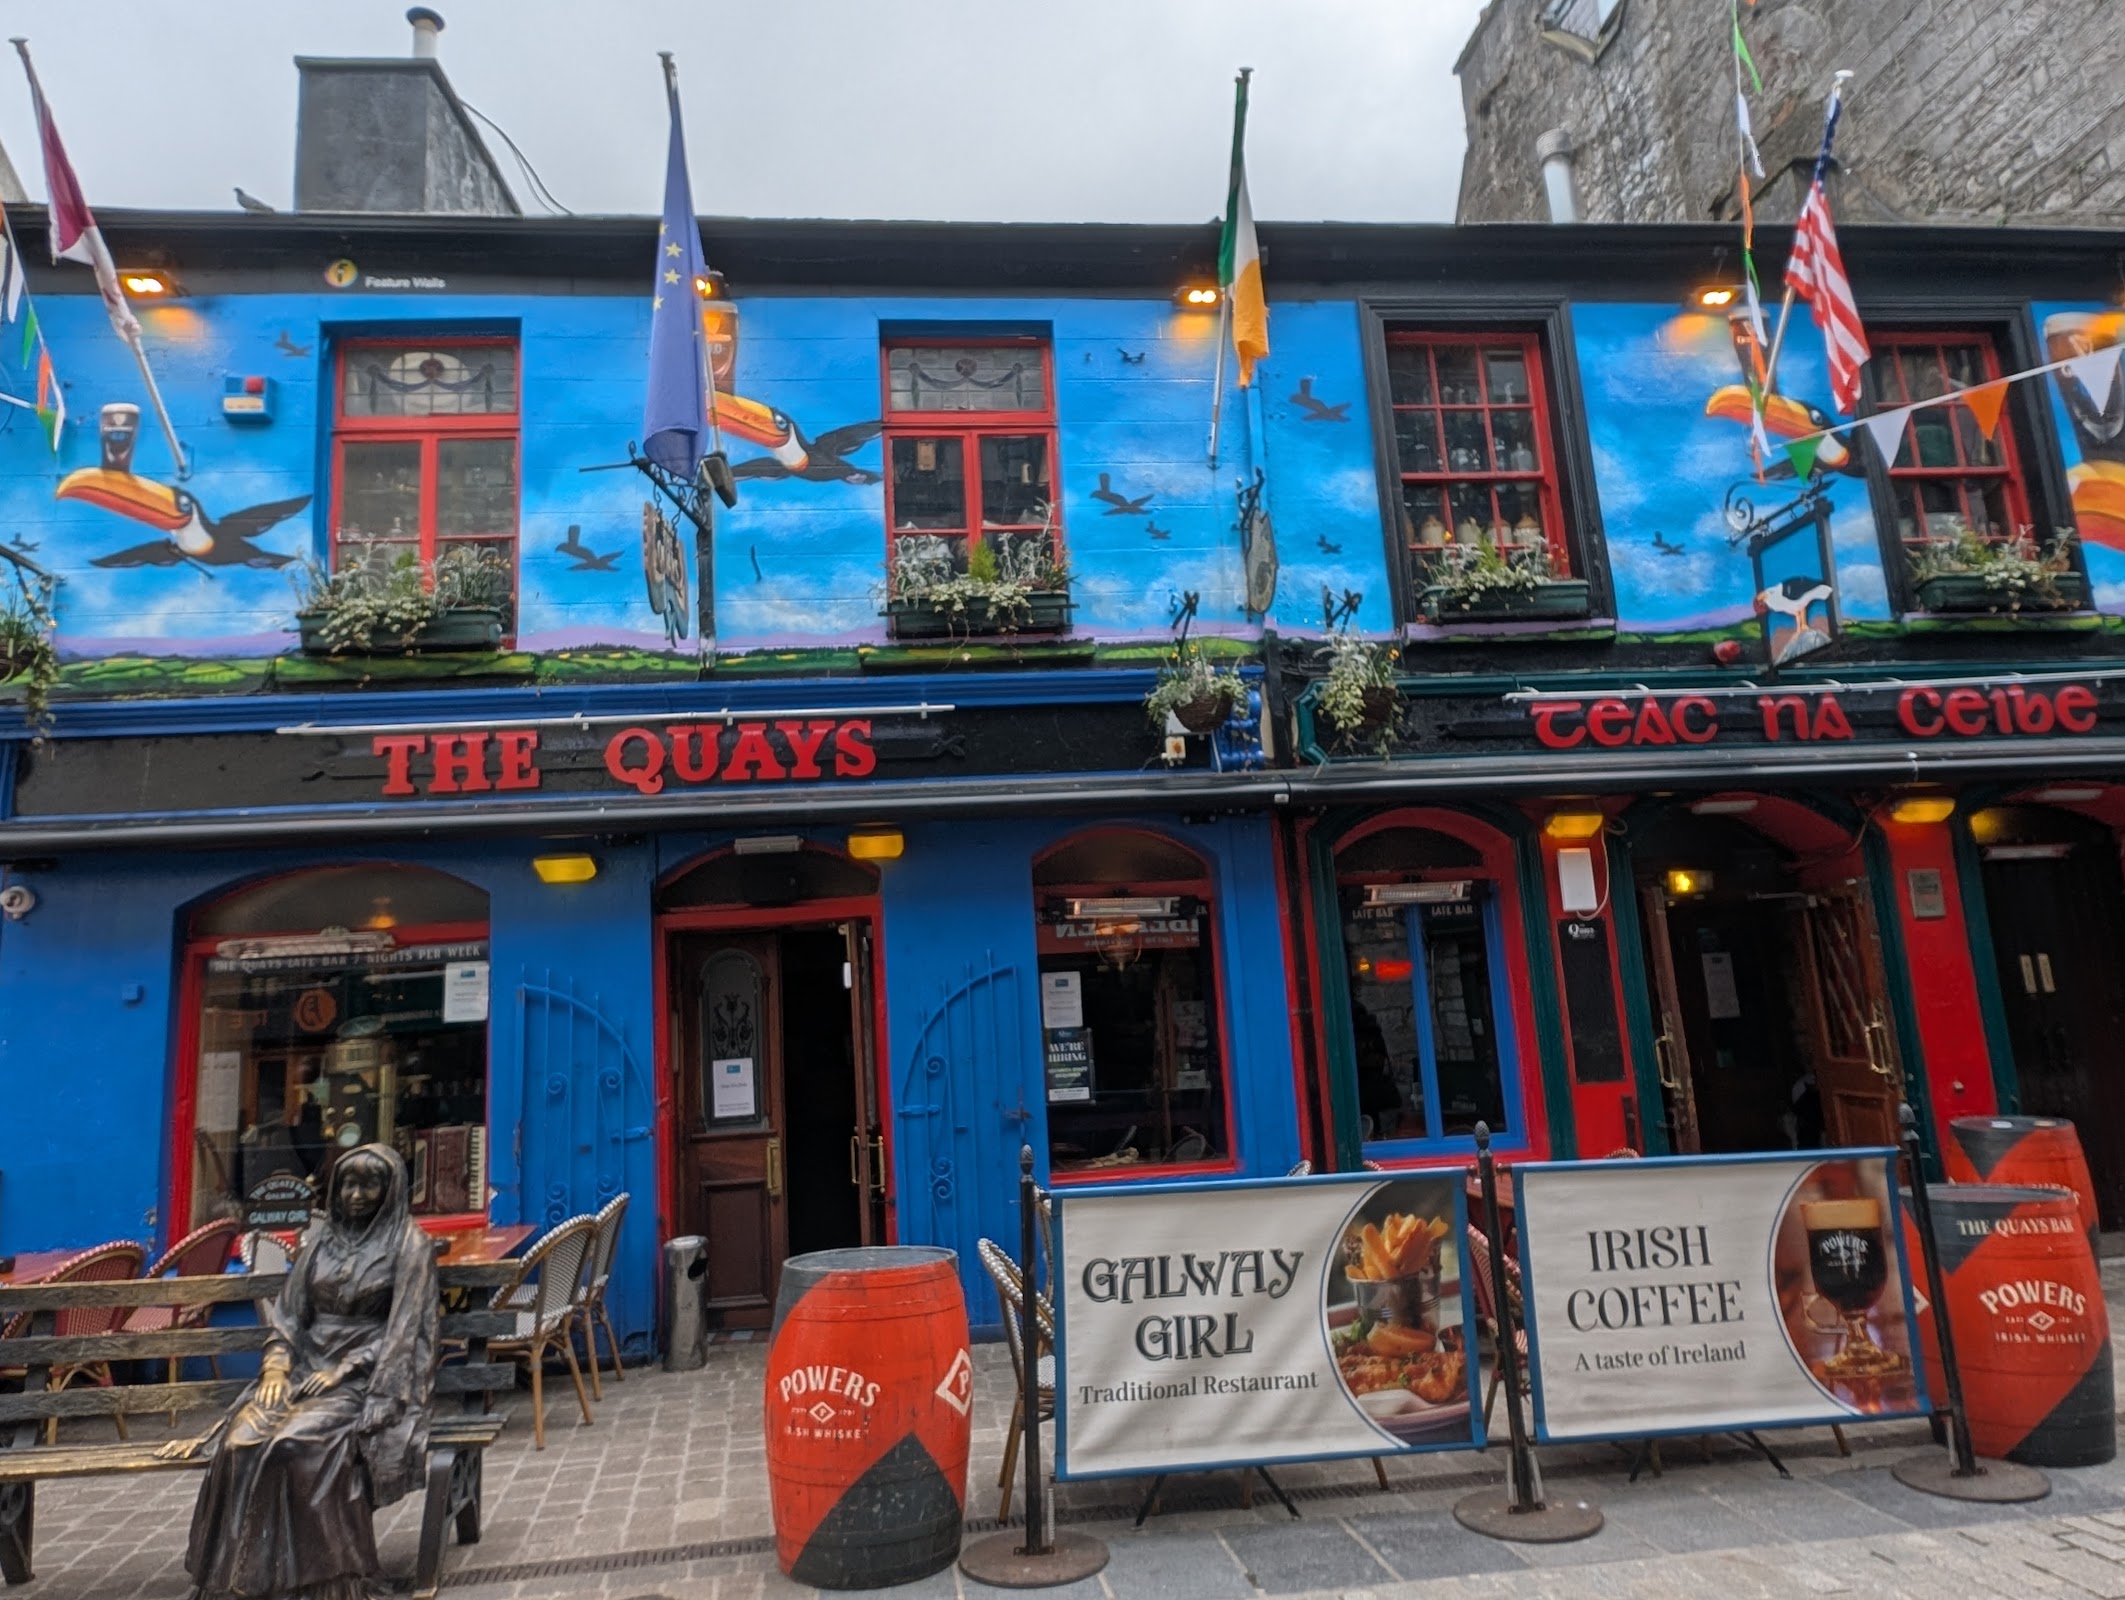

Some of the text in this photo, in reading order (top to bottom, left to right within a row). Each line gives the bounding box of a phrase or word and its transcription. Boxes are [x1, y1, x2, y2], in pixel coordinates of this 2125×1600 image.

[365, 276, 446, 288] Feature Walls
[372, 719, 876, 795] THE QUAYS
[367, 949, 414, 963] NIGHTS
[418, 947, 441, 960] PER
[447, 945, 481, 957] WEEK
[1957, 1218, 2074, 1237] THE QUAYS BAR
[1587, 1225, 1712, 1272] IRISH
[1082, 1248, 1304, 1304] GALWAY
[1567, 1280, 1744, 1332] COFFEE
[1979, 1280, 2087, 1316] POWERS
[1135, 1312, 1254, 1361] GIRL
[1575, 1340, 1746, 1371] A taste of Ireland
[780, 1366, 881, 1407] POWERS
[1080, 1372, 1319, 1405] Traditional Restaurant
